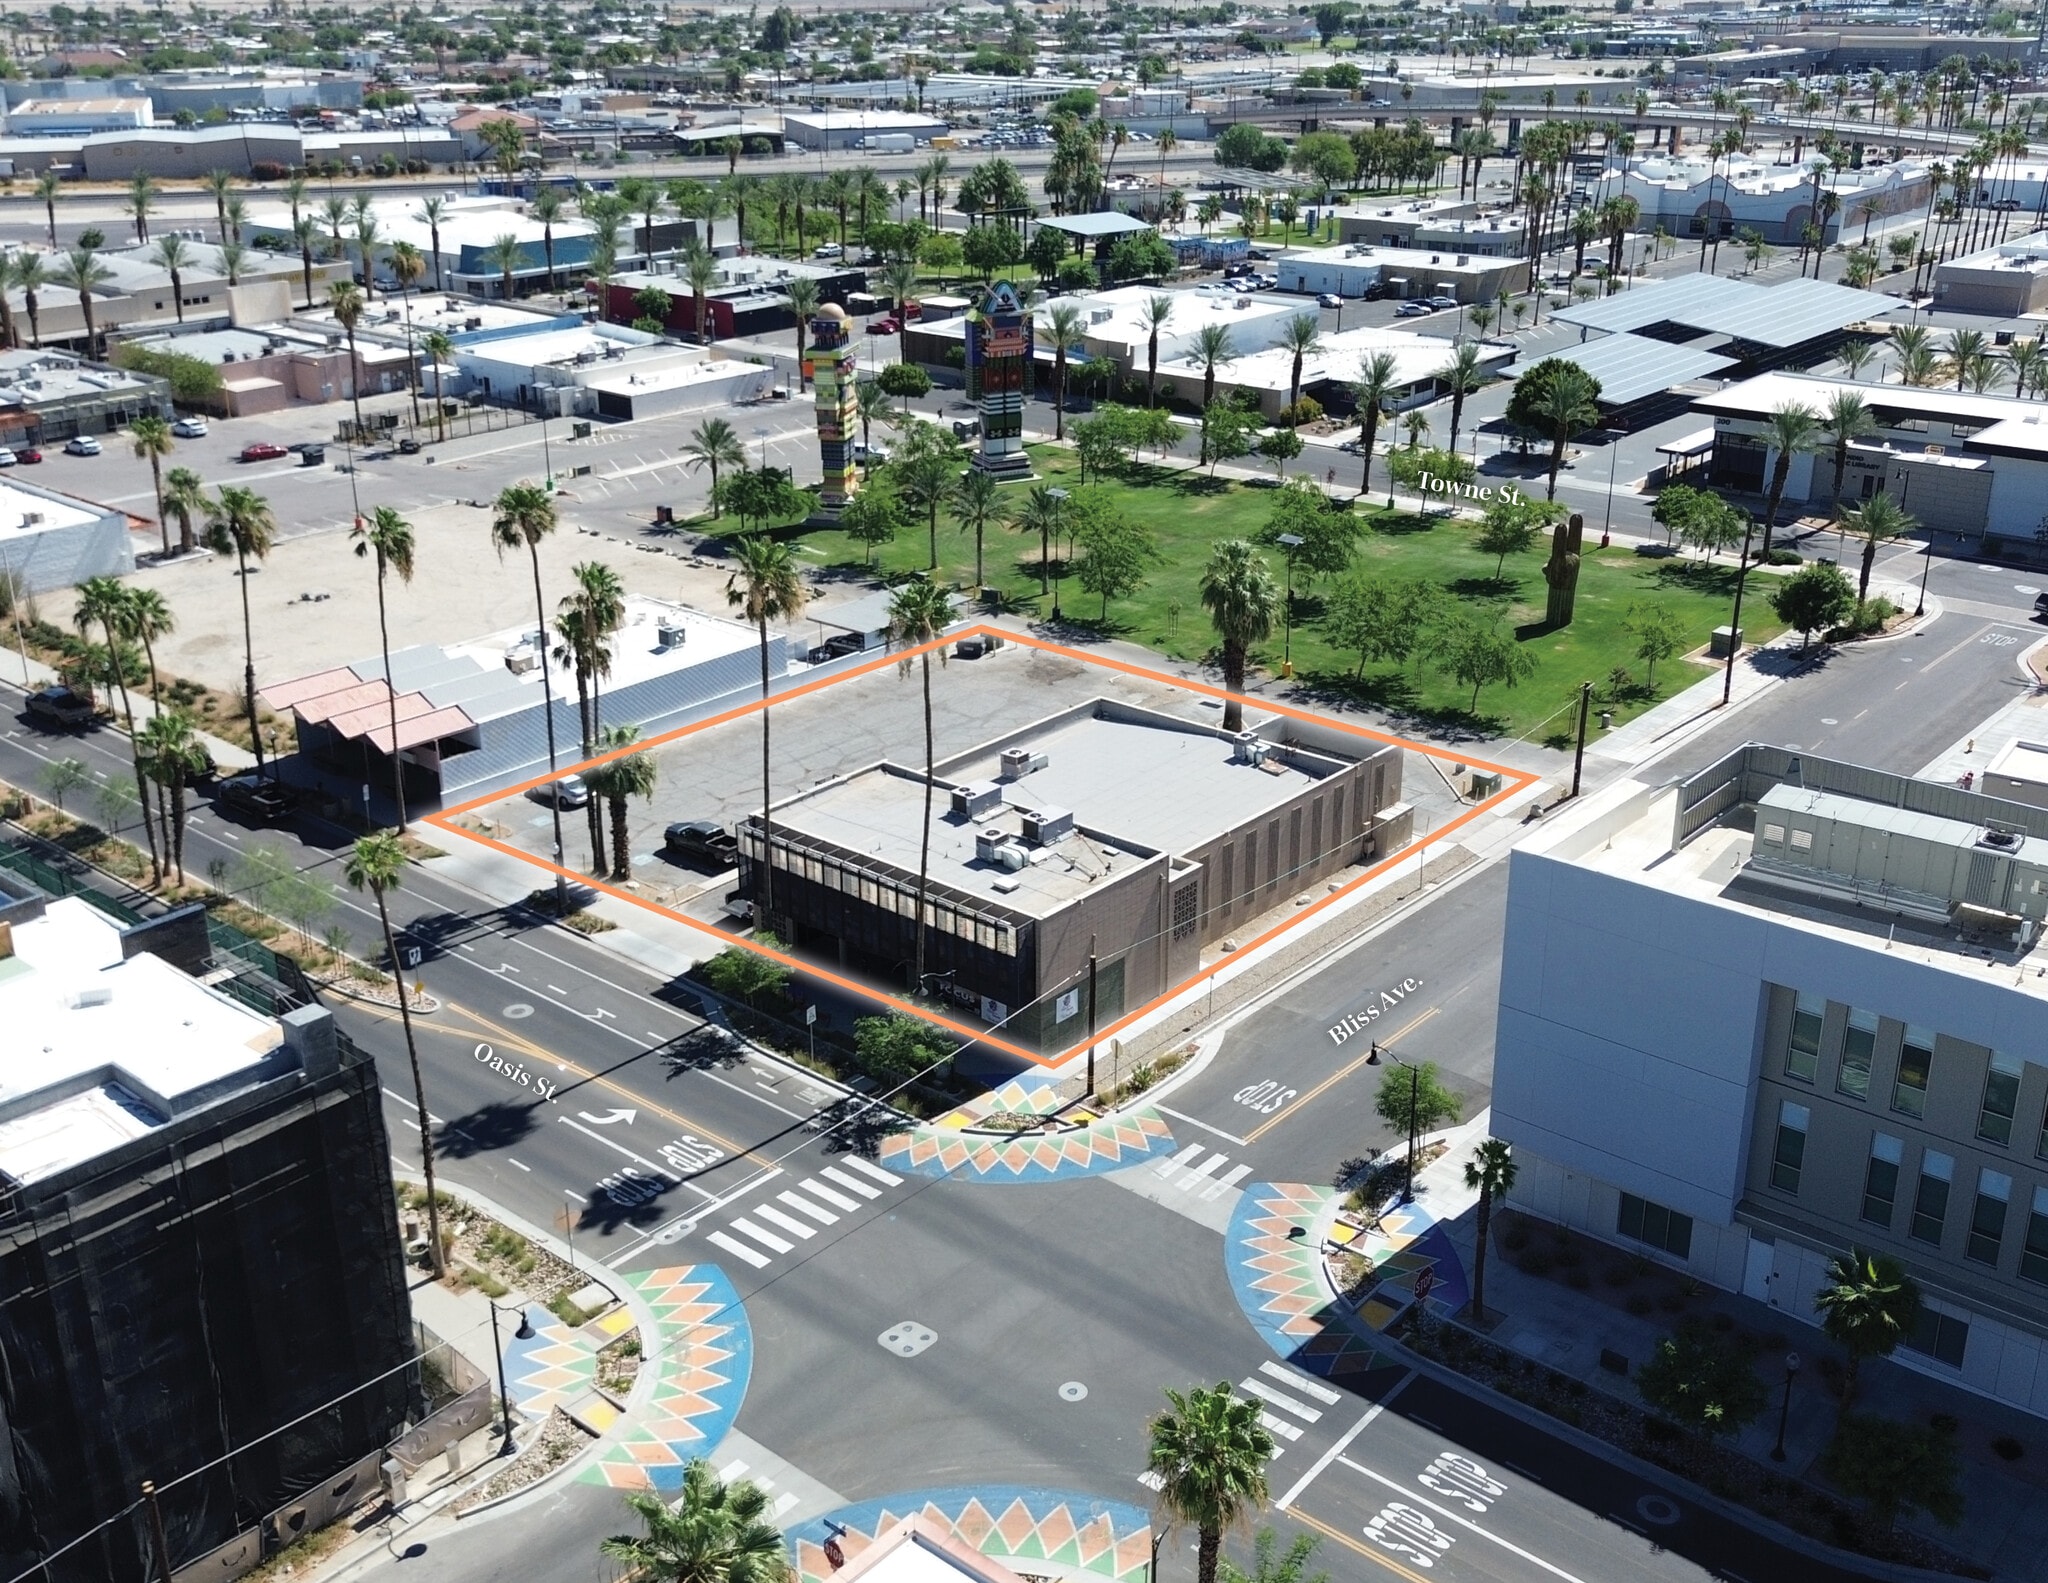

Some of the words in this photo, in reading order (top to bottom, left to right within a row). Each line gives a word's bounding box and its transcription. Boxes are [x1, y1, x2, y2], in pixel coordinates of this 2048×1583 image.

[1716, 418, 1731, 426] 200
[1827, 458, 1851, 466] PUC
[1852, 461, 1881, 470] LIBRARY
[1845, 454, 1864, 462] NDIO
[1980, 633, 2018, 647] STOP
[1233, 1079, 1297, 1114] STOP
[657, 1135, 725, 1173] STOP
[595, 1167, 665, 1207] STOP
[1415, 1272, 1433, 1294] STOP
[1417, 1451, 1508, 1513] STOP
[1363, 1502, 1457, 1568] STOP
[826, 1542, 844, 1563] STOP
